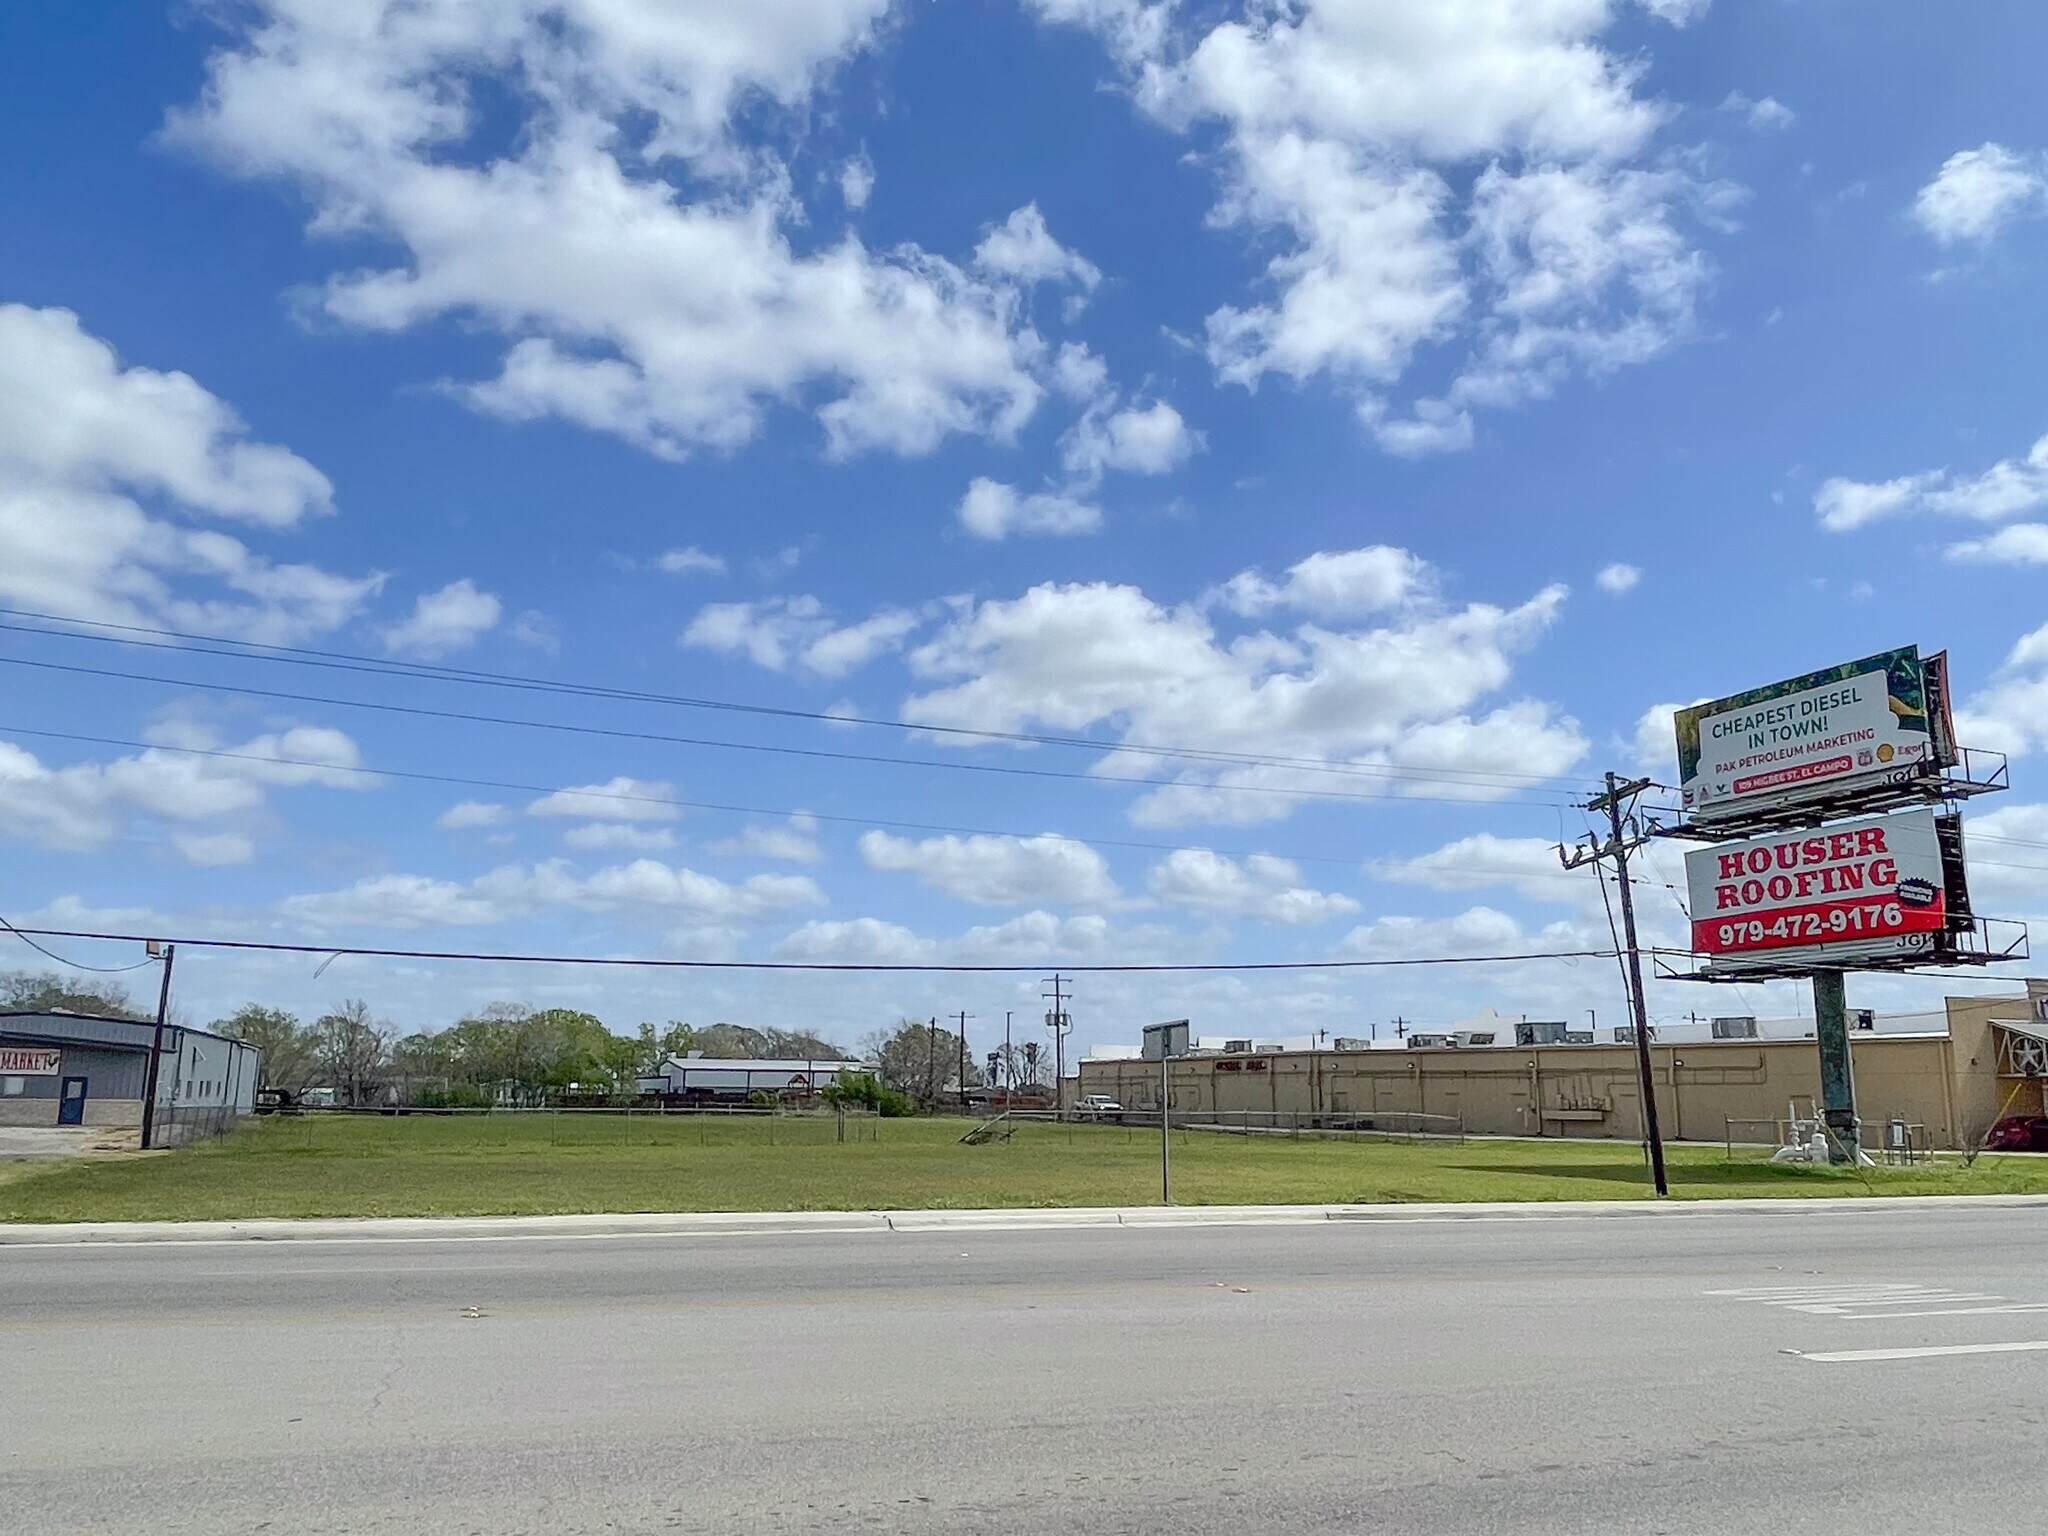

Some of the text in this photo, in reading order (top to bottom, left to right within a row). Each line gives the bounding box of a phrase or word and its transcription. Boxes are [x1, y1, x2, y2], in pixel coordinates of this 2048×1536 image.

[1711, 687, 1863, 739] CHEAPEST DIESEL
[1748, 715, 1829, 750] IN TOWN!
[1715, 728, 1875, 774] PAK PETROLEUM MARKETING
[1801, 766, 1814, 777] EL
[1814, 759, 1849, 775] CAMPO
[1717, 827, 1888, 880] HOUSER
[1714, 858, 1899, 910] ROOFING
[1718, 902, 1903, 946] 979-472-9176
[1, 1052, 50, 1070] MARKET
